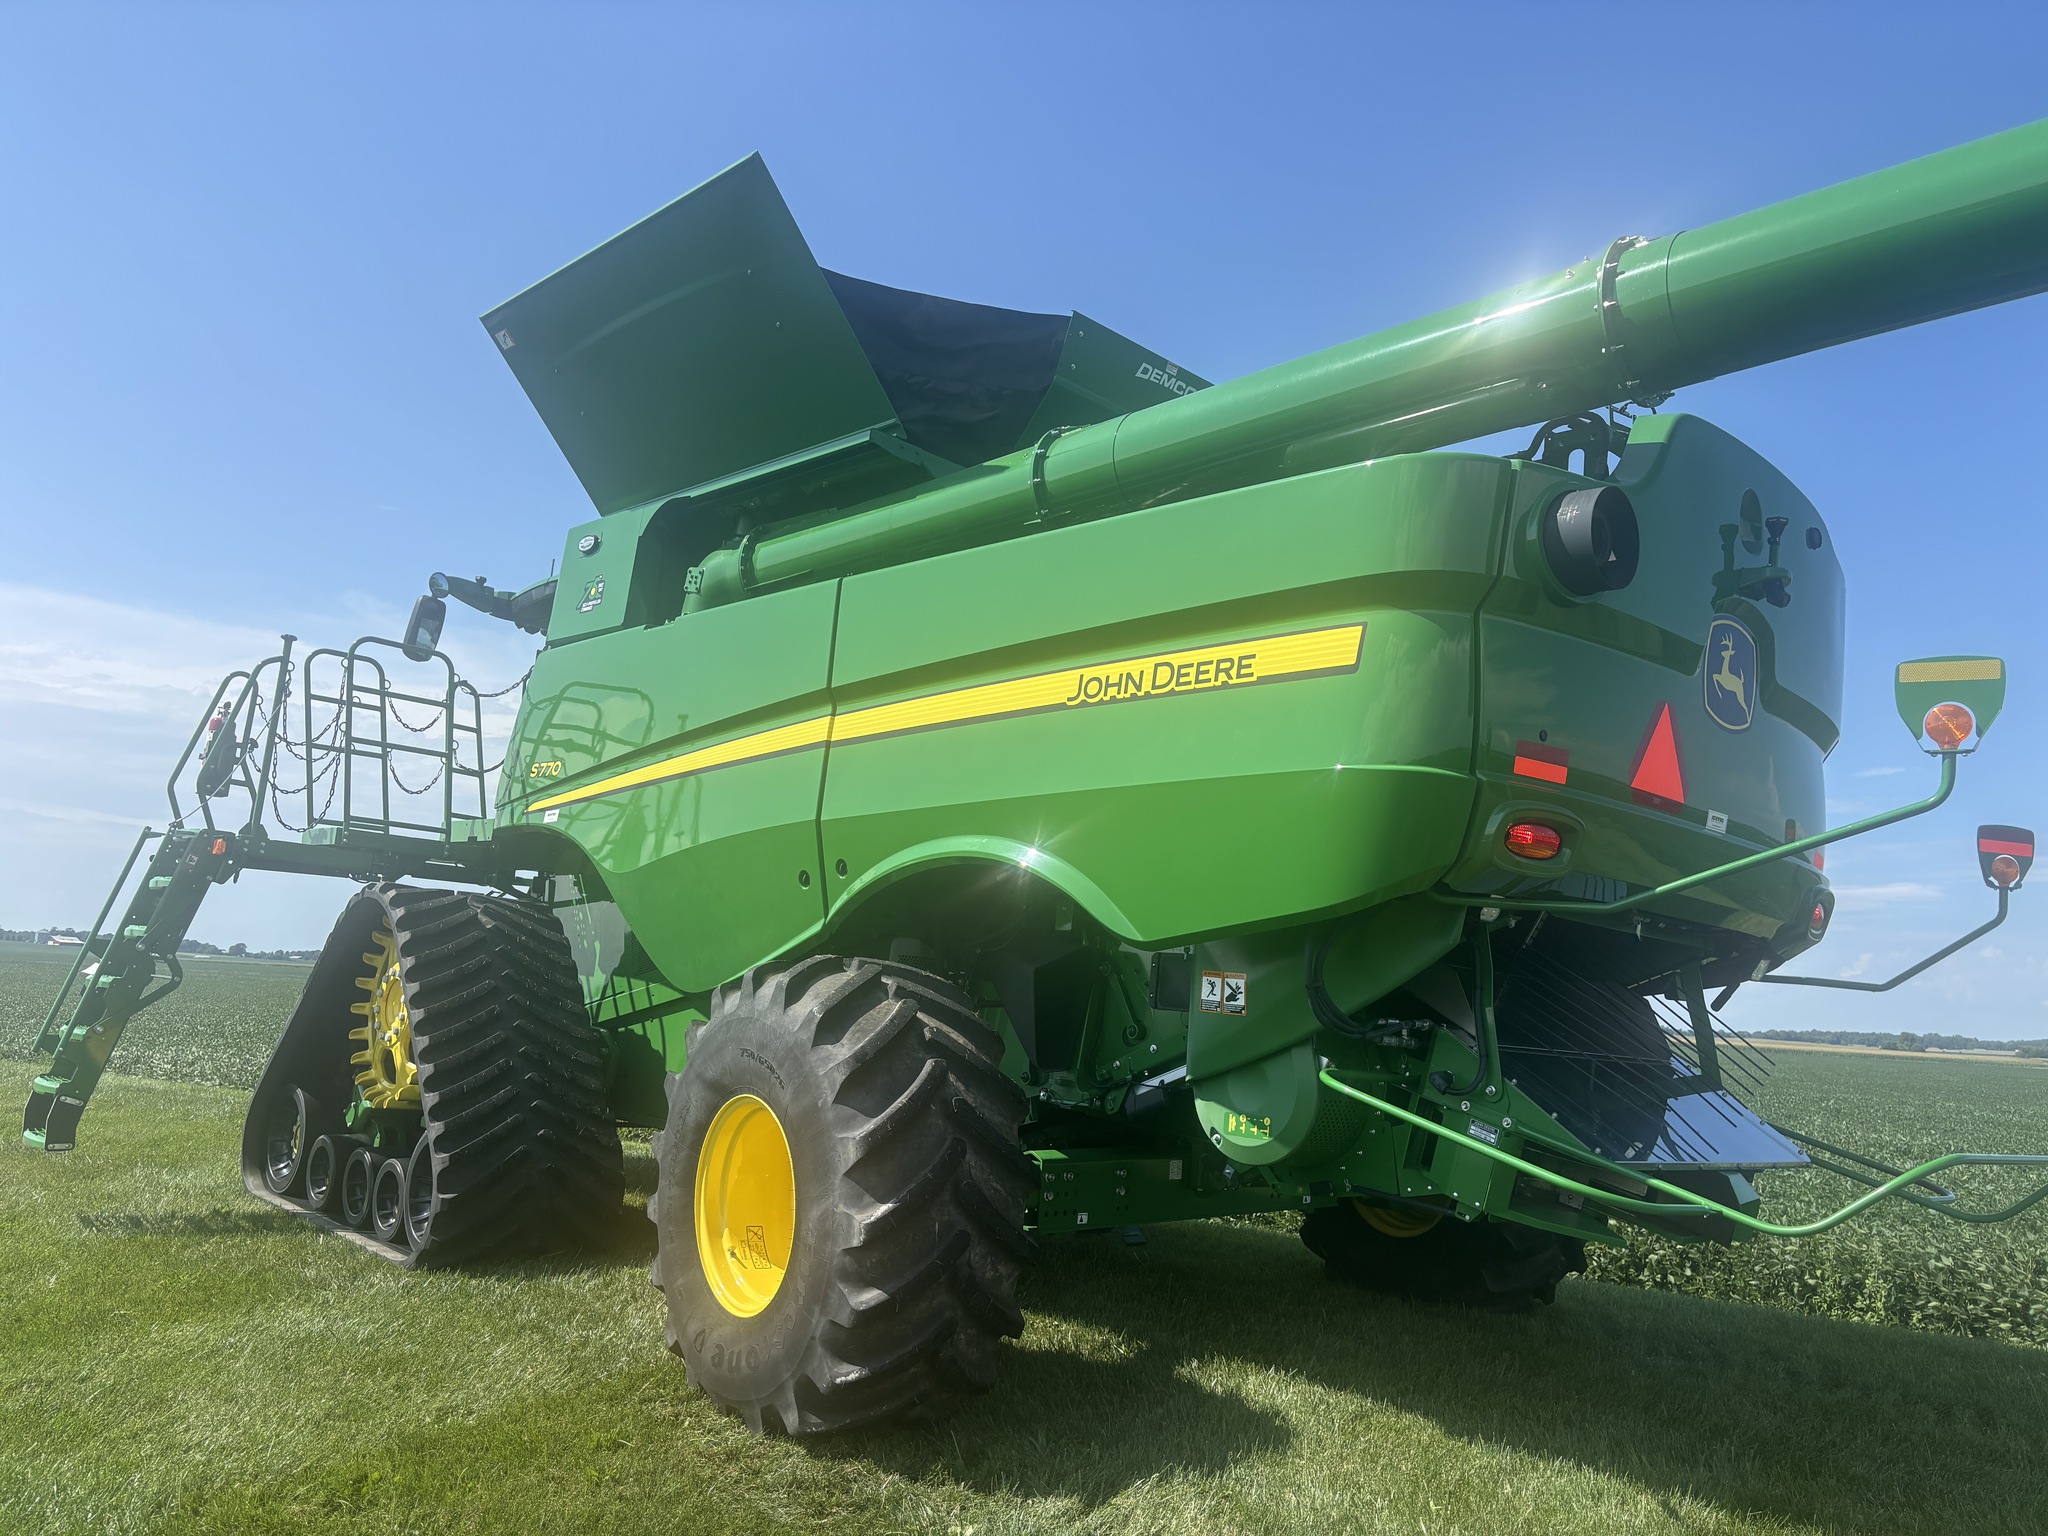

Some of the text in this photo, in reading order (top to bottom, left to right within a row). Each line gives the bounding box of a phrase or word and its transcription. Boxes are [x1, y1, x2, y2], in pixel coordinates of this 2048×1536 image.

[1135, 362, 1197, 396] DEMCO
[1067, 654, 1257, 702] JOHN DEERE
[530, 760, 562, 778] S770
